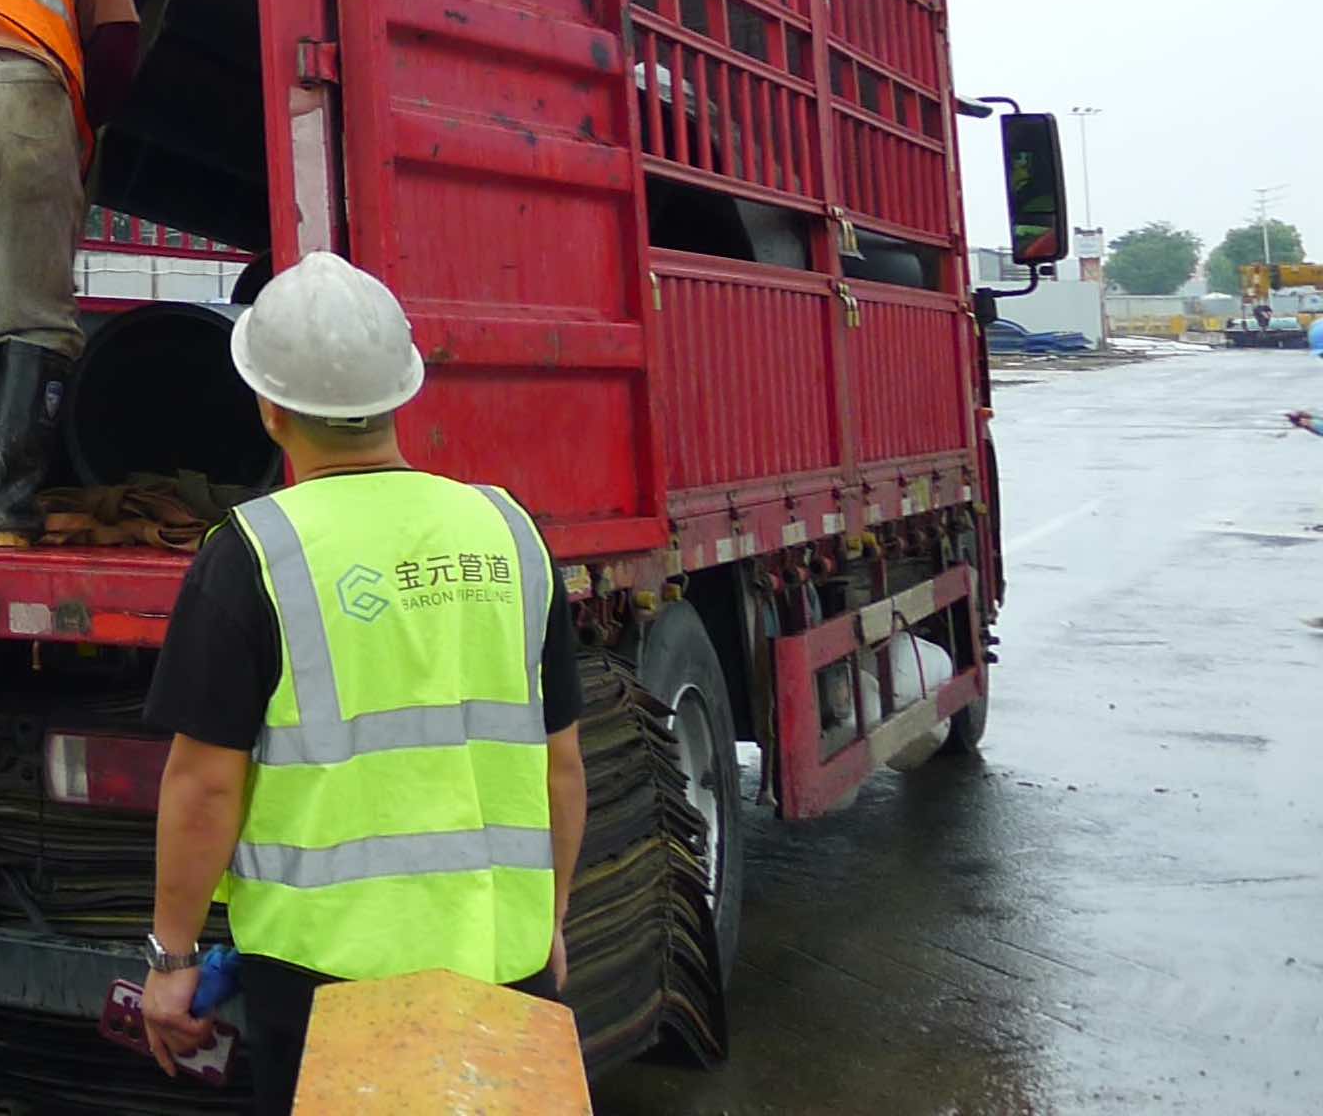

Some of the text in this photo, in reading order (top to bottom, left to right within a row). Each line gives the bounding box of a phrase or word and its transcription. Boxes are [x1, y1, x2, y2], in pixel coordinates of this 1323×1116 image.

[395, 553, 513, 591] 宝元管道
[457, 587, 515, 604] IPELNE
